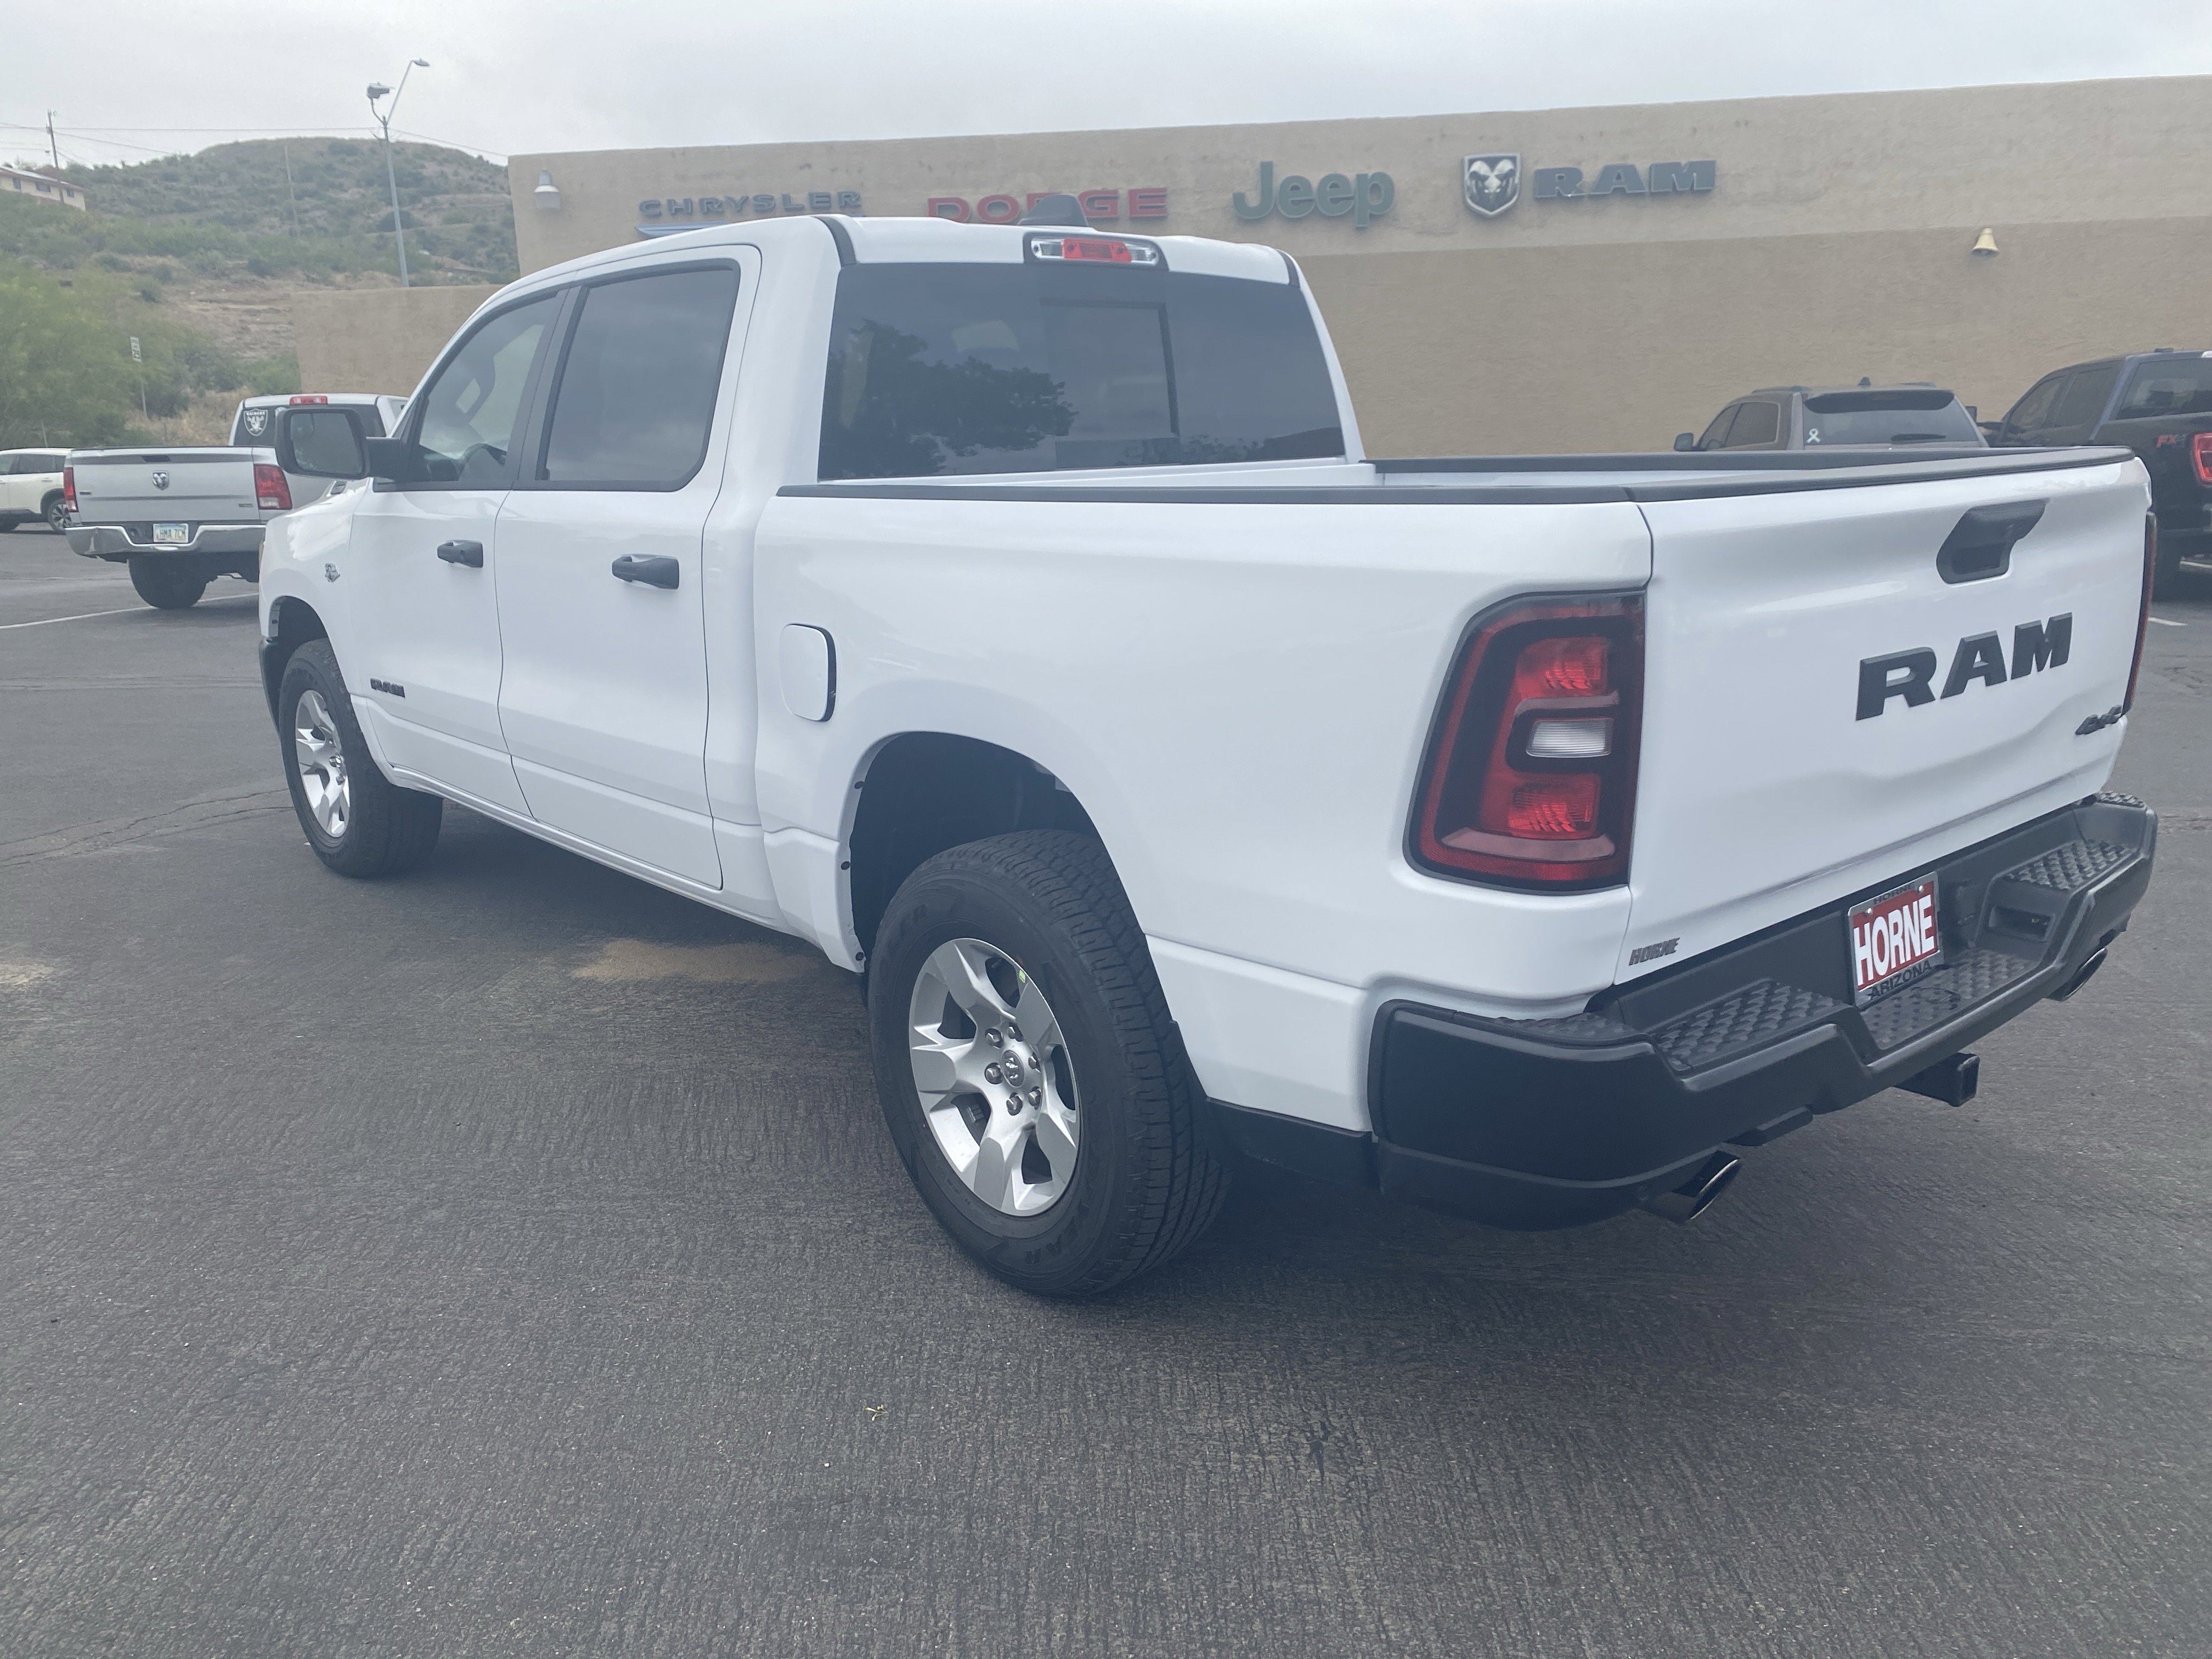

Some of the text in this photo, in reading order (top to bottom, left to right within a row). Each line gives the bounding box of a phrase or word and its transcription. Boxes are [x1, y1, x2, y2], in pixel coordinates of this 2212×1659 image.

[1232, 160, 1396, 228] Jeep
[1535, 160, 1716, 198] RAM
[639, 191, 861, 217] CHRYSLER
[1855, 612, 2073, 721] RAM
[370, 678, 405, 698] RAM
[1874, 882, 1915, 905] HORNE
[1628, 937, 1680, 966] HORNE
[1853, 894, 1935, 986] HORNE
[1867, 960, 1933, 998] ARIZONA
